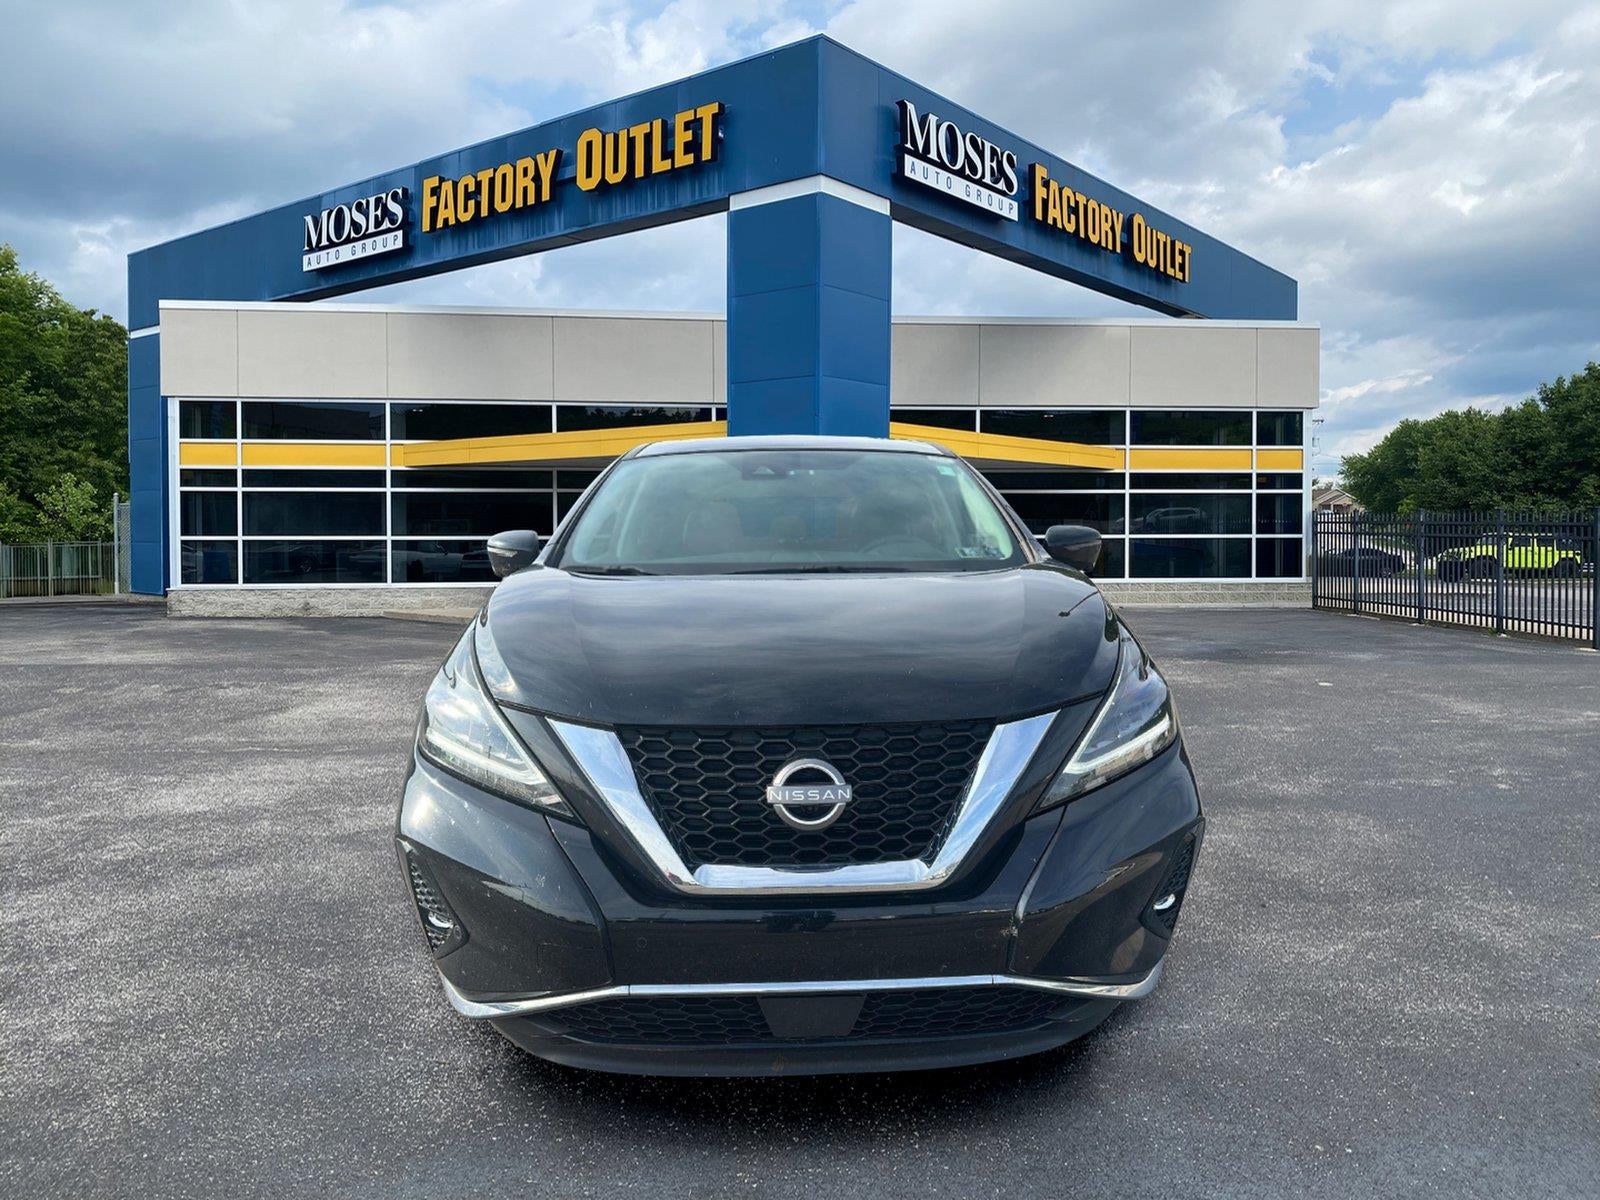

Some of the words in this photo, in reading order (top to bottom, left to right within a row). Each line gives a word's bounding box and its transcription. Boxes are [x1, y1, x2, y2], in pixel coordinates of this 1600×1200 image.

[903, 99, 1019, 196] MOSES
[909, 160, 953, 190] AUTO
[964, 184, 1015, 215] GROUP
[303, 187, 404, 251] MOSES
[306, 249, 342, 268] AUTO
[350, 234, 400, 257] GROUP
[769, 788, 850, 801] NISSAN
